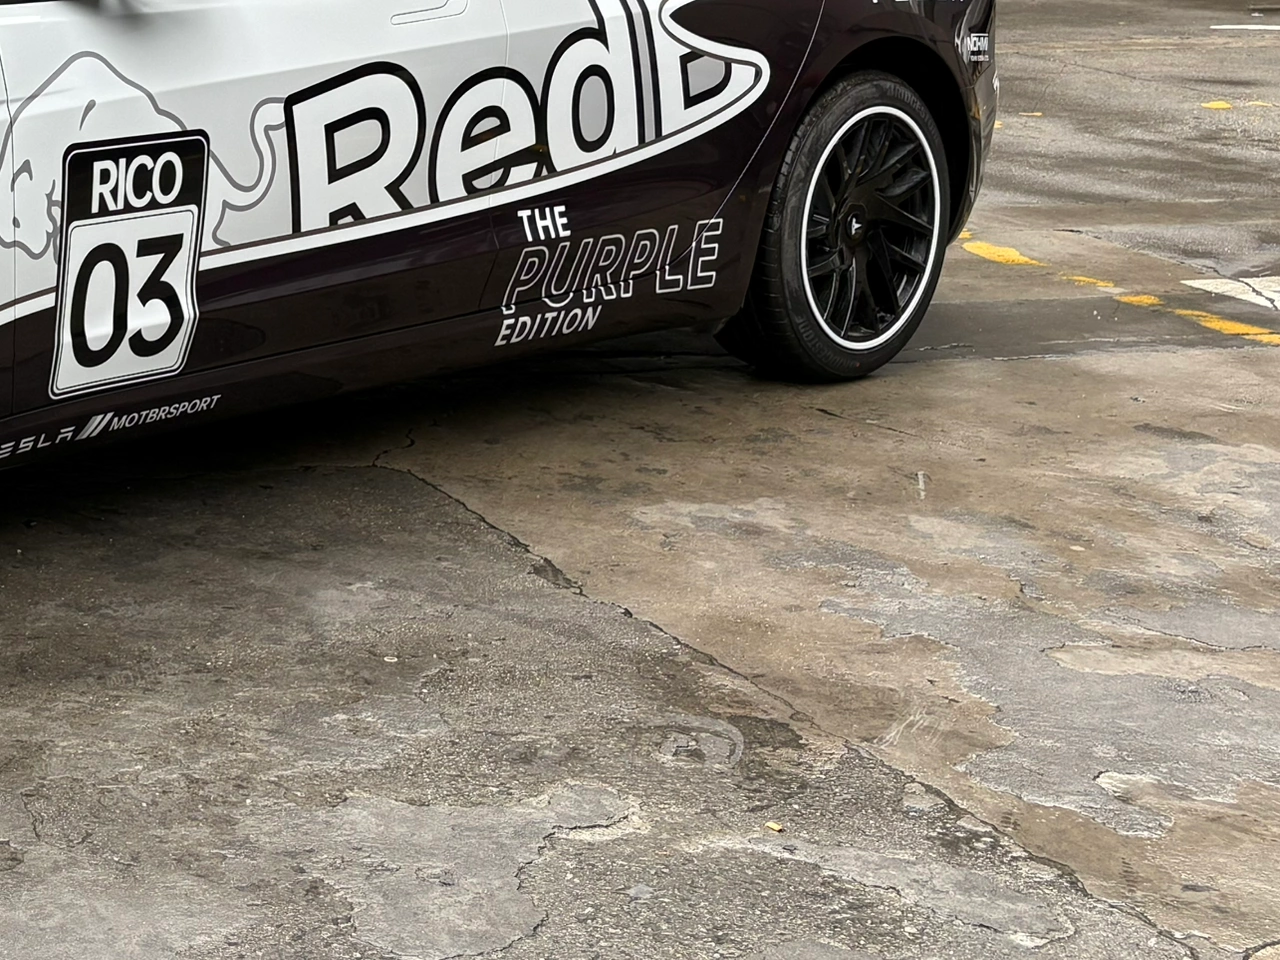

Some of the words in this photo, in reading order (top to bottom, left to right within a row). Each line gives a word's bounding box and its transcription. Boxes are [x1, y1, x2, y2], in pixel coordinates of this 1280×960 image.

[91, 151, 184, 214] RICO
[517, 205, 571, 242] THE
[501, 218, 724, 314] PURPLE
[70, 232, 185, 368] 03
[494, 304, 603, 347] EDITION
